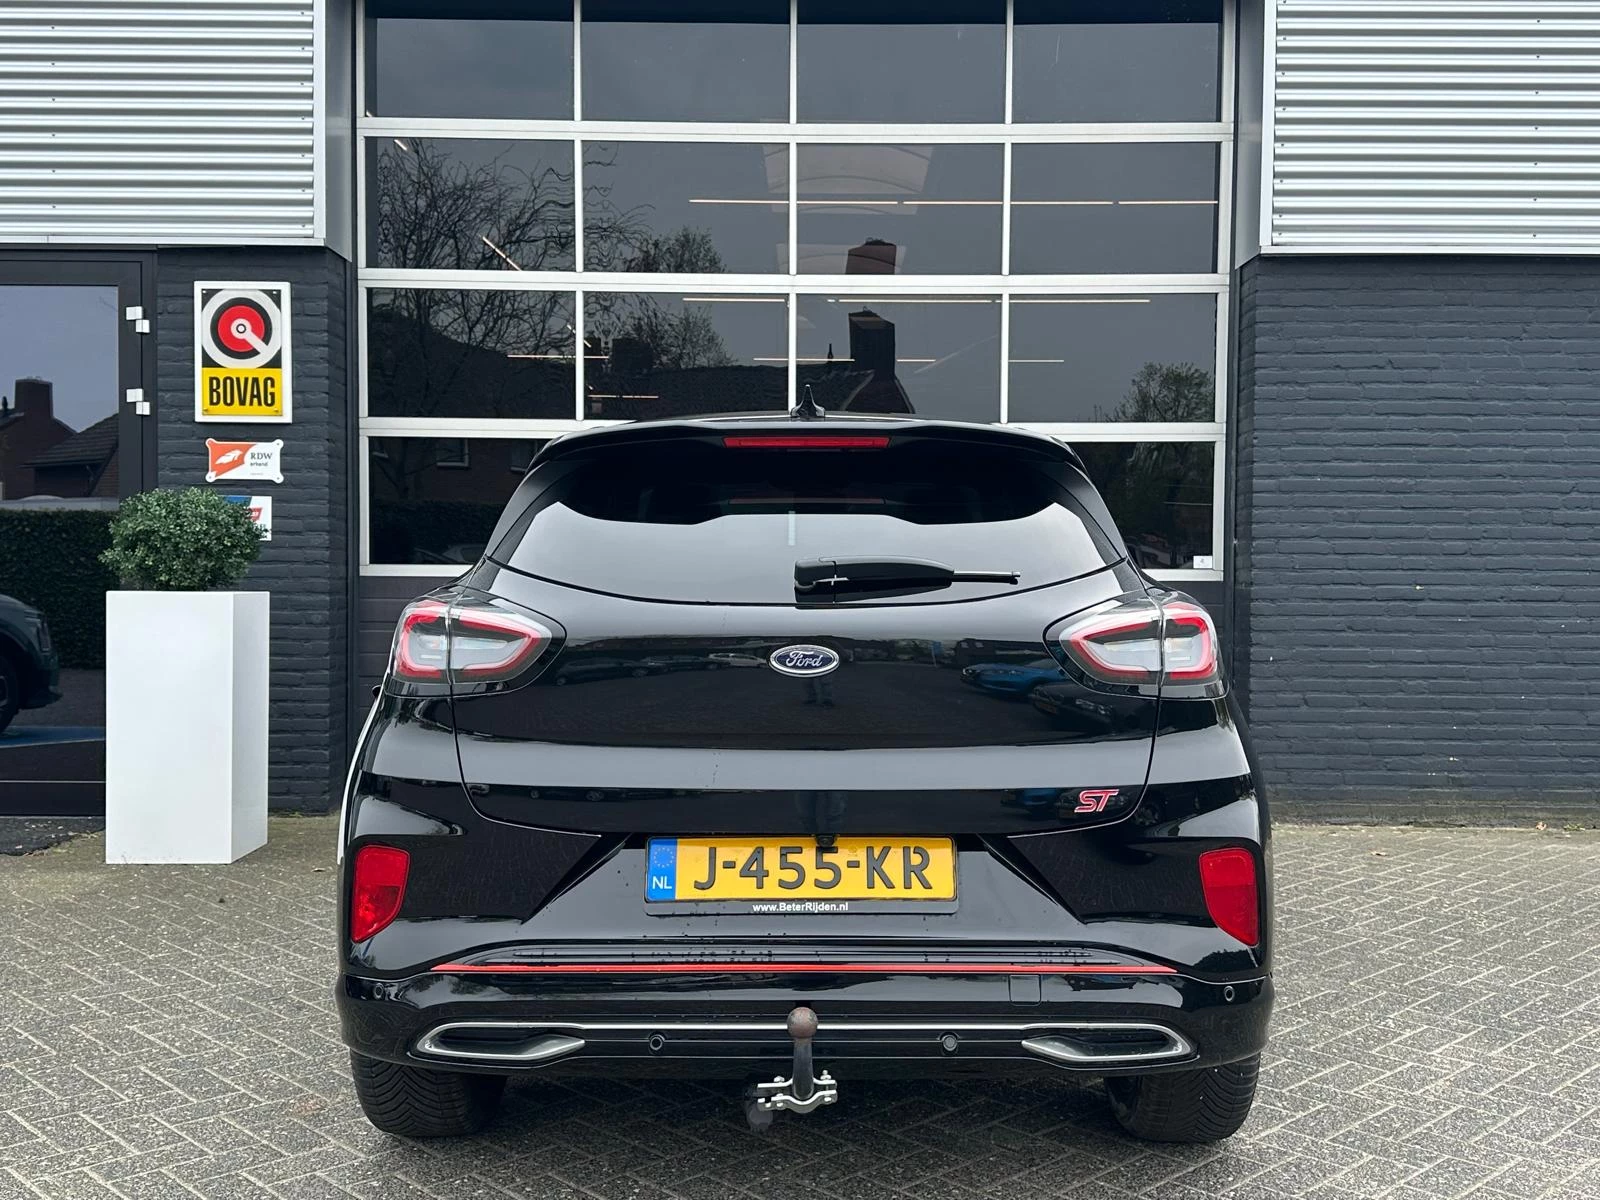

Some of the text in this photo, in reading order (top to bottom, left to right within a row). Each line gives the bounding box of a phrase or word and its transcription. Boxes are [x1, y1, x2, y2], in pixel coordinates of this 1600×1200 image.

[209, 376, 275, 407] BOVAG
[250, 452, 273, 460] RDW
[786, 651, 823, 666] Ford
[1074, 789, 1119, 812] ST
[694, 846, 933, 889] J-455-KR
[652, 876, 672, 889] NL
[752, 902, 849, 913] www.BeterRijden.nl
